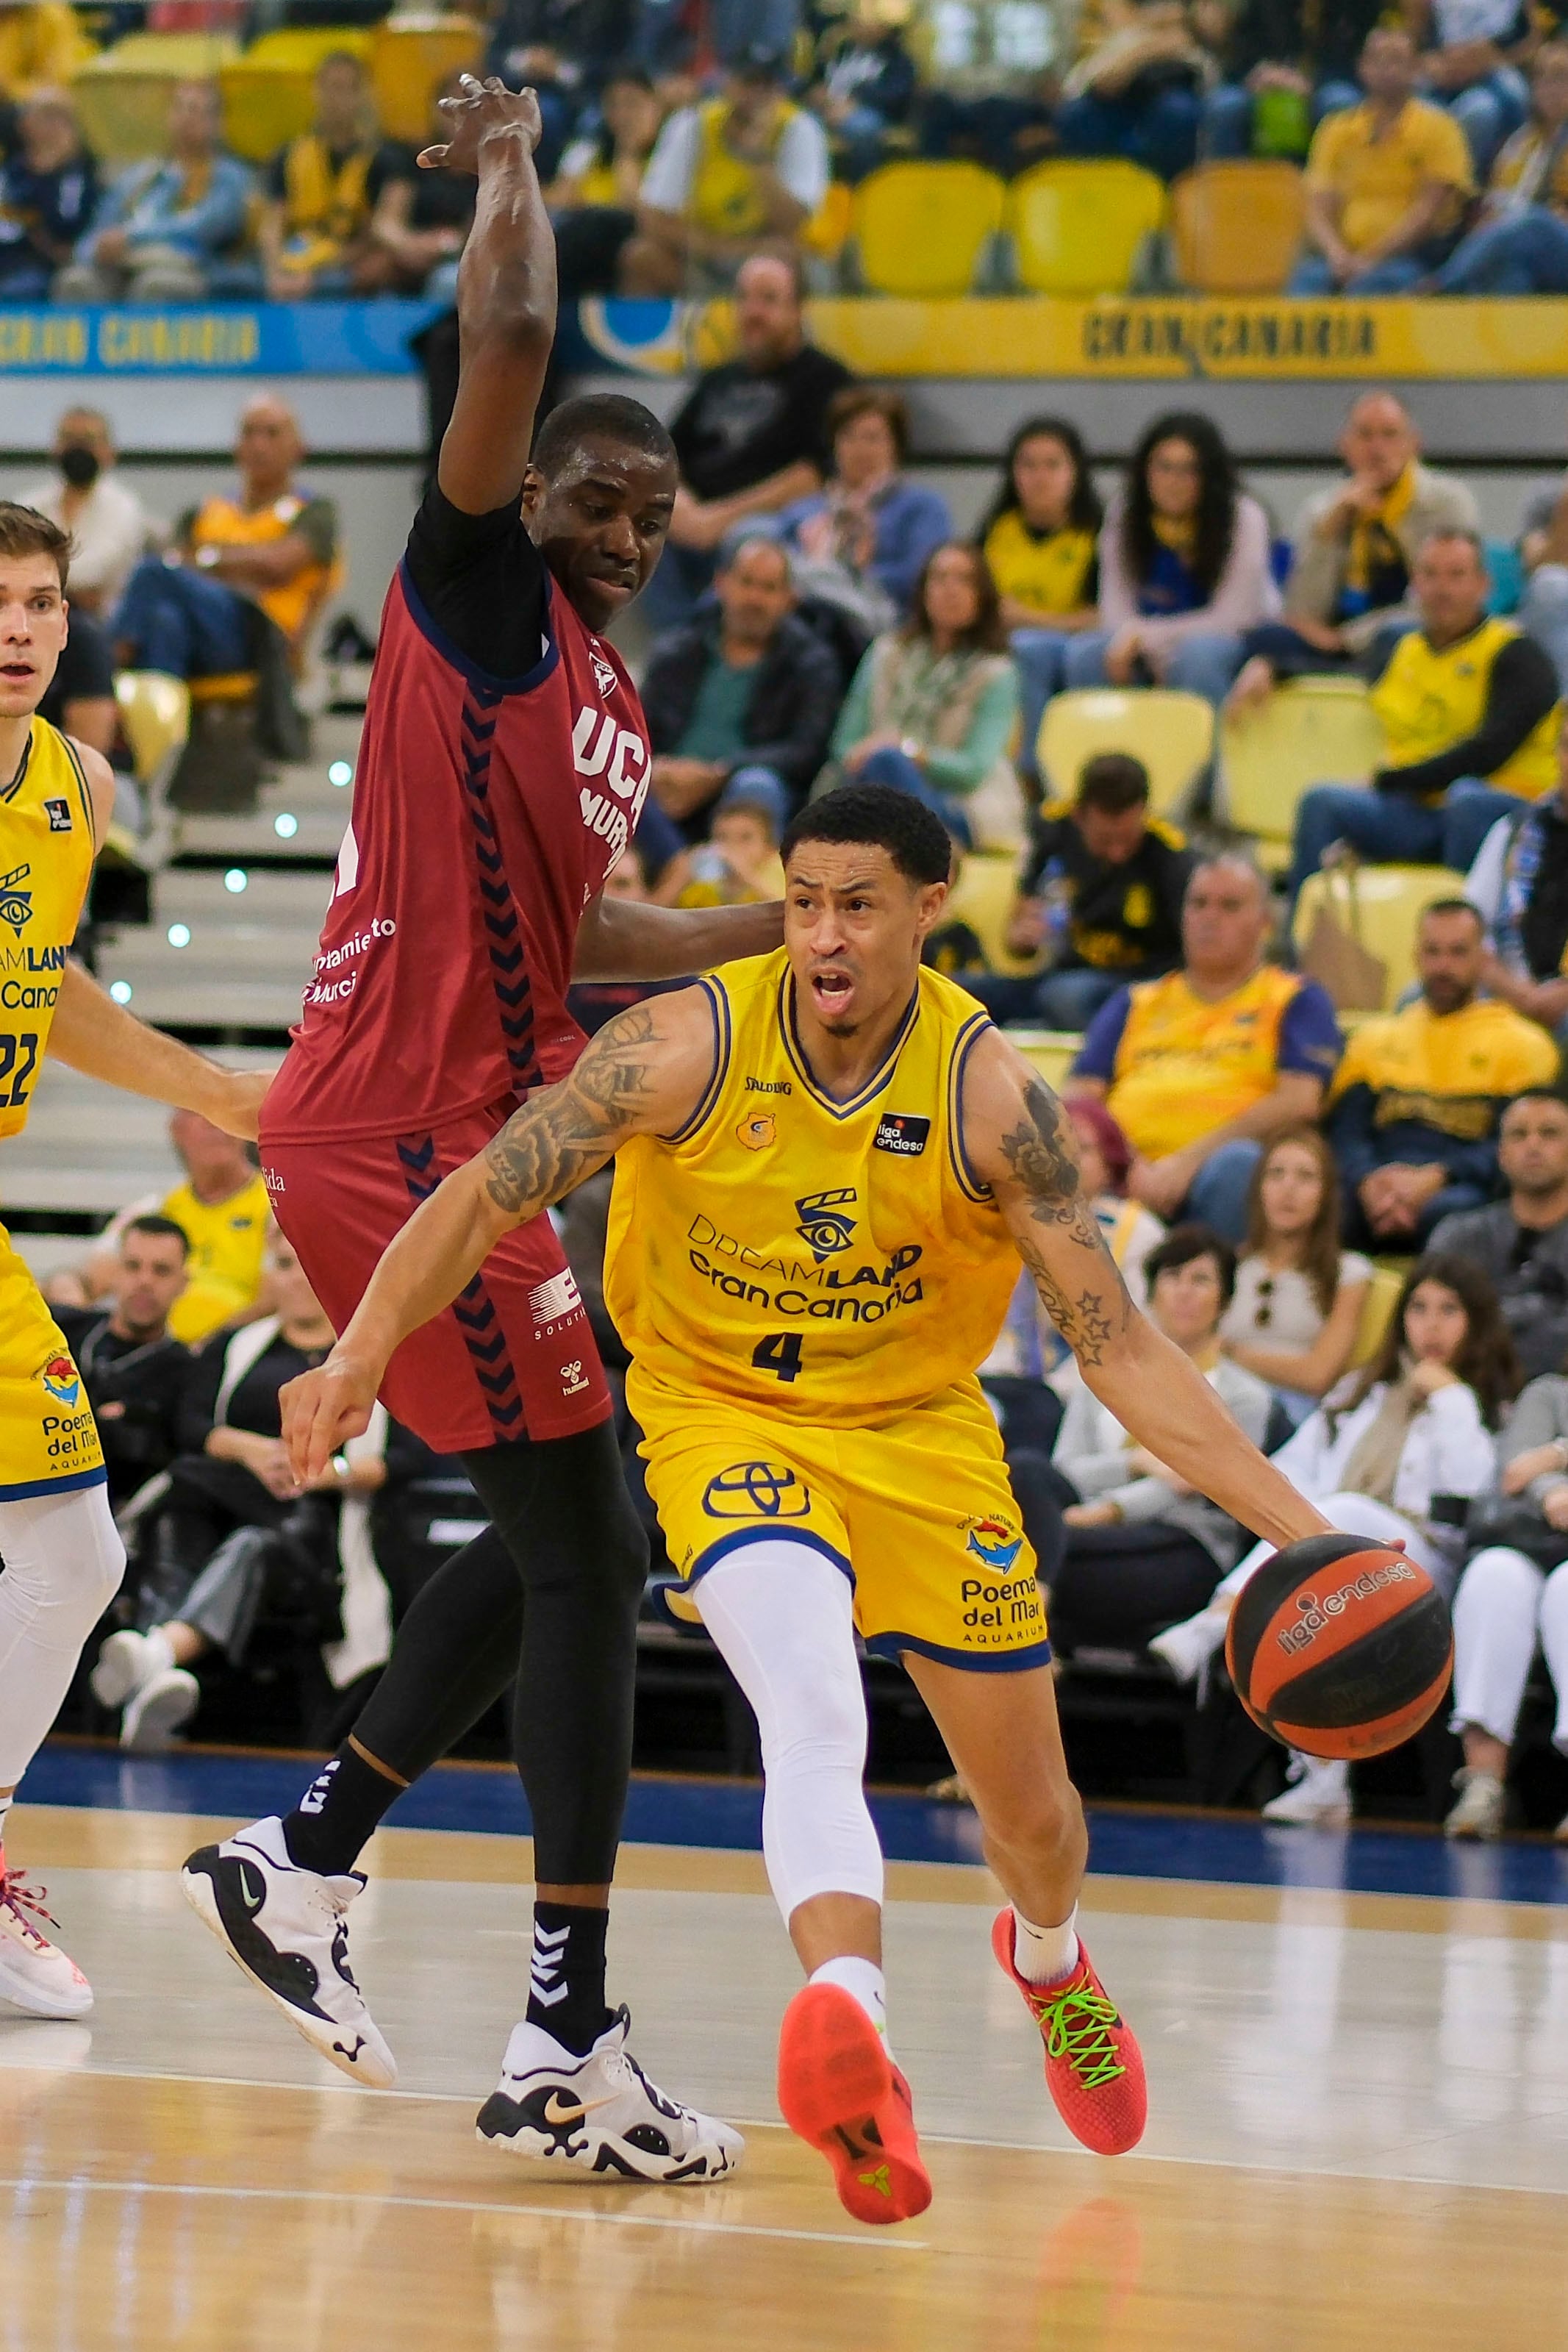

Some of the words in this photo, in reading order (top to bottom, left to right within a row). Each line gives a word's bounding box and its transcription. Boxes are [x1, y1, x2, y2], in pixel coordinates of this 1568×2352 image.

[745, 1076, 792, 1096] SPALDING
[878, 1124, 901, 1138] liga
[876, 1138, 924, 1151] endesa
[751, 1332, 803, 1383] 4
[48, 1434, 78, 1456] del
[961, 1576, 1036, 1604] Poema
[962, 1606, 1003, 1627] del
[1012, 1600, 1039, 1623] Mar
[1276, 1606, 1329, 1658] liga
[1322, 1562, 1417, 1616] endesa
[963, 1624, 1044, 1644] AQUARIUM
